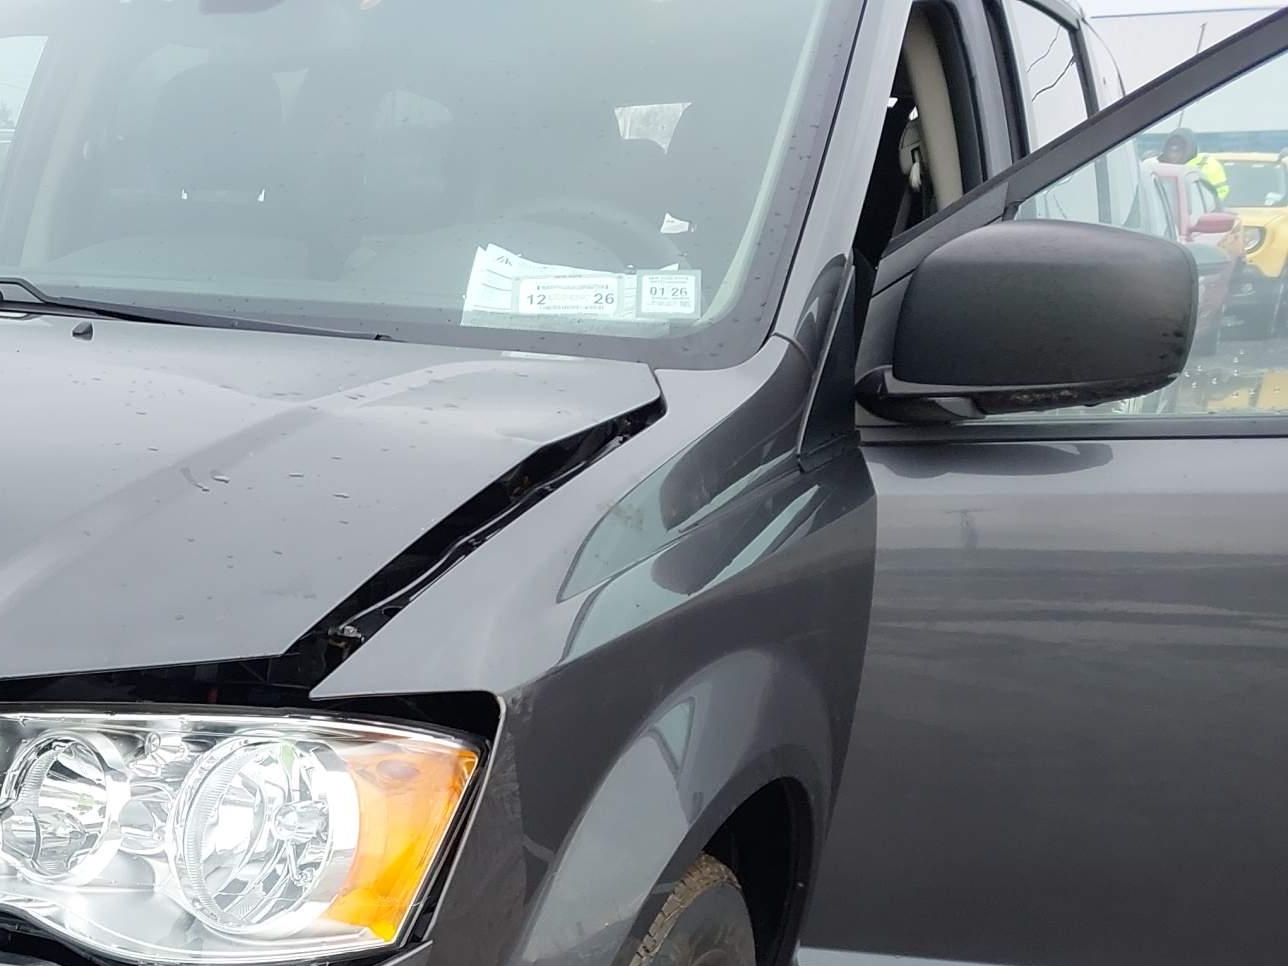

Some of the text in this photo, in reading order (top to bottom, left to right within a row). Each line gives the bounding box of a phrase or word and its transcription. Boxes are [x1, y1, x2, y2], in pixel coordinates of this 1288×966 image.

[649, 286, 688, 297] 01 26
[526, 292, 615, 305] 12 26
